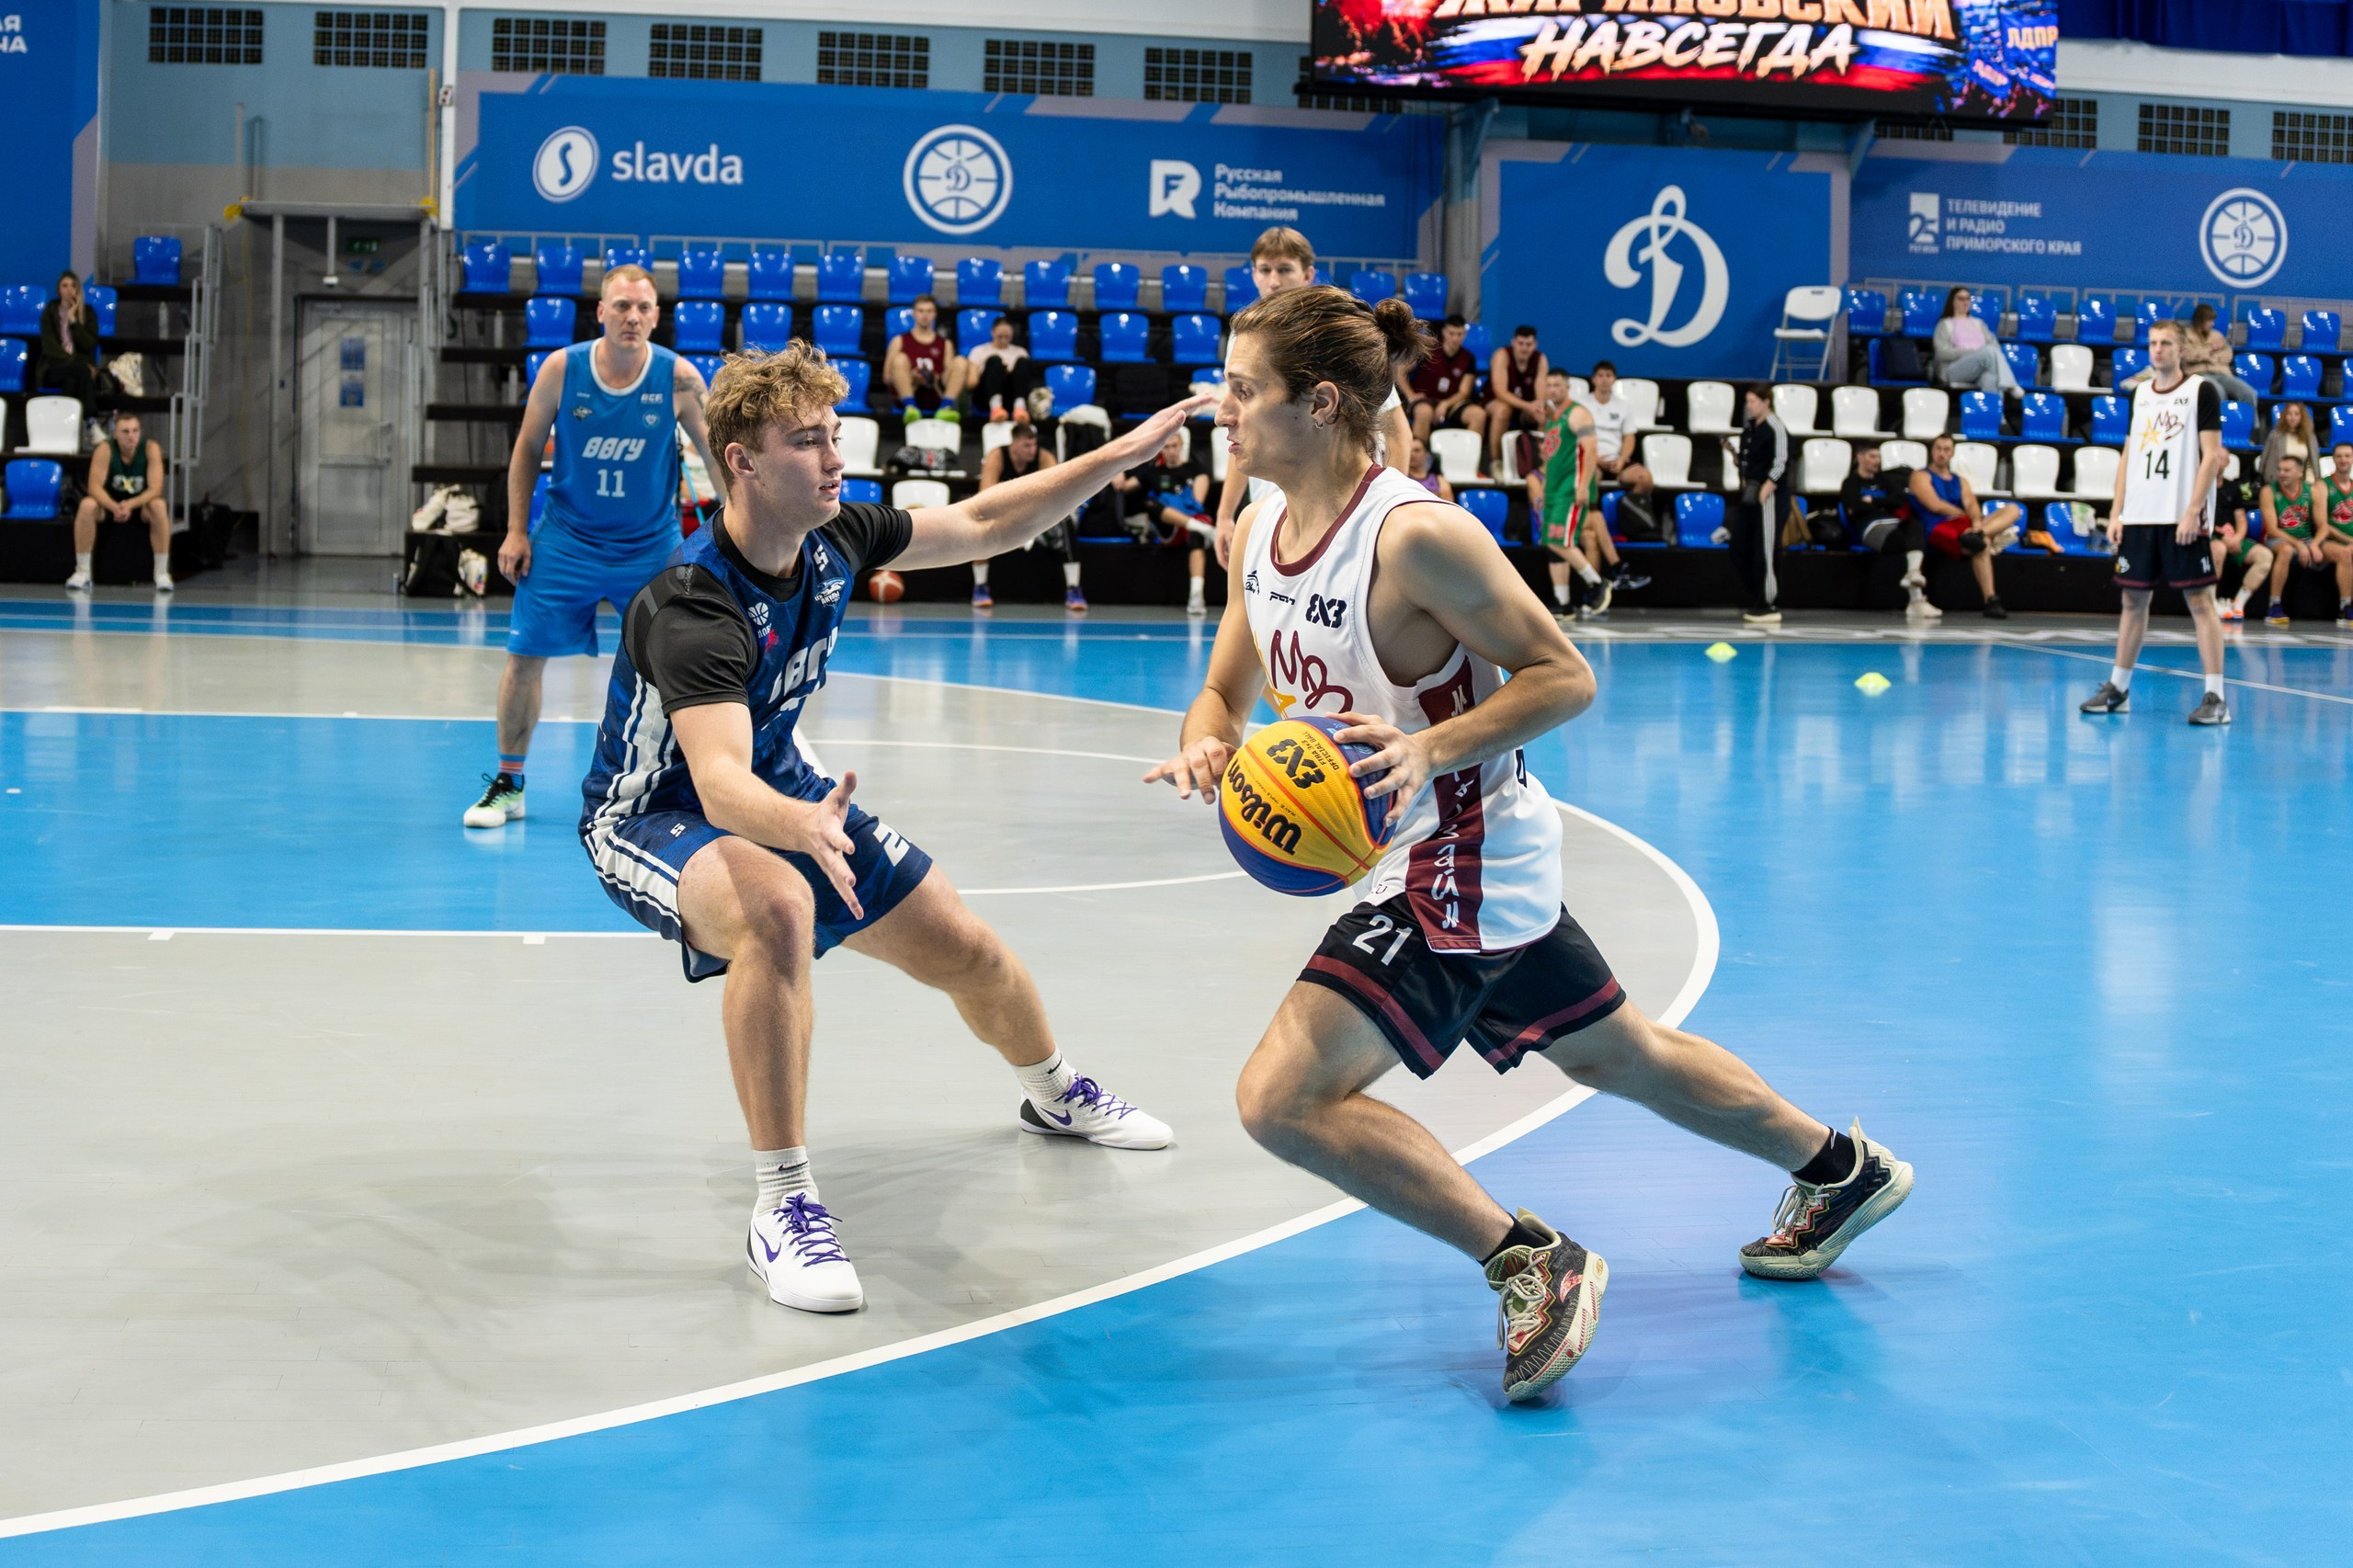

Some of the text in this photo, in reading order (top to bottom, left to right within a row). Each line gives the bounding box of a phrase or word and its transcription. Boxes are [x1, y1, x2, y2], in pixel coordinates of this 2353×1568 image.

[1518, 16, 1860, 84] НАВСЕГДА
[2006, 26, 2058, 51] ЛДПР
[611, 141, 744, 185] slavda
[1214, 164, 1283, 184] Русская
[1214, 183, 1386, 207] Рыбопромышленная
[1213, 201, 1299, 222] Компания
[1947, 199, 2042, 218] ТЕЛЕВИДЕНИЕ
[1946, 218, 2006, 234] И РАДИО
[1946, 235, 2082, 256] ПРИМОРСКОГО КРАЯ
[2146, 449, 2170, 480] 14
[597, 468, 625, 497] 11
[1315, 744, 1339, 770] OFFICIAL
[1227, 758, 1302, 856] Wilson
[1352, 915, 1413, 966] 21
